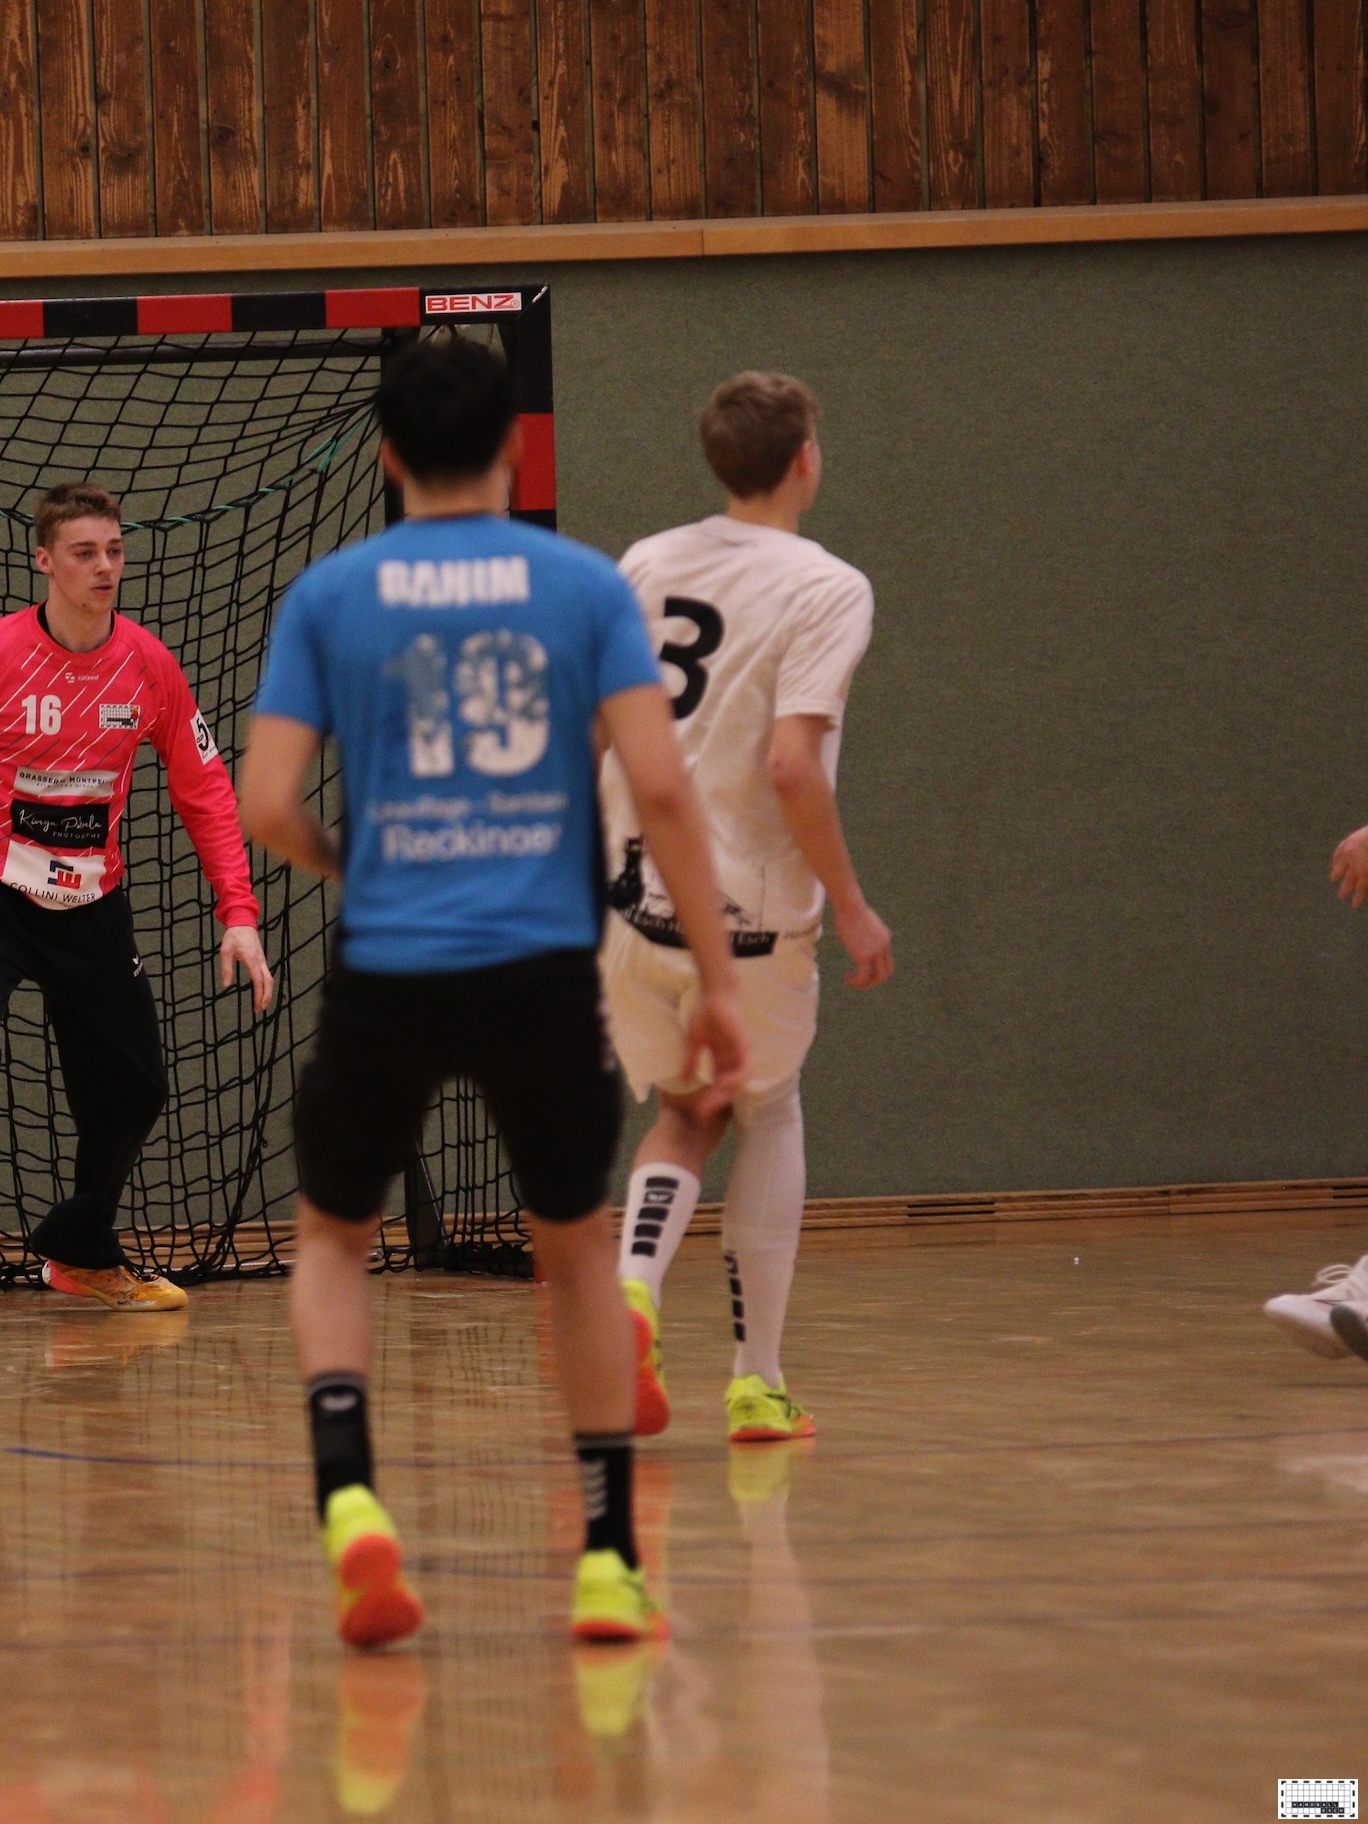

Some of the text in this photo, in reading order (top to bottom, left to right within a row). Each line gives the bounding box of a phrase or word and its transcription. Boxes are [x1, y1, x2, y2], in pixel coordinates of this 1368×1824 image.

[427, 294, 515, 311] BENZ
[659, 596, 724, 720] 3
[21, 694, 62, 735] 16
[10, 882, 96, 903] COLLINI WELTER
